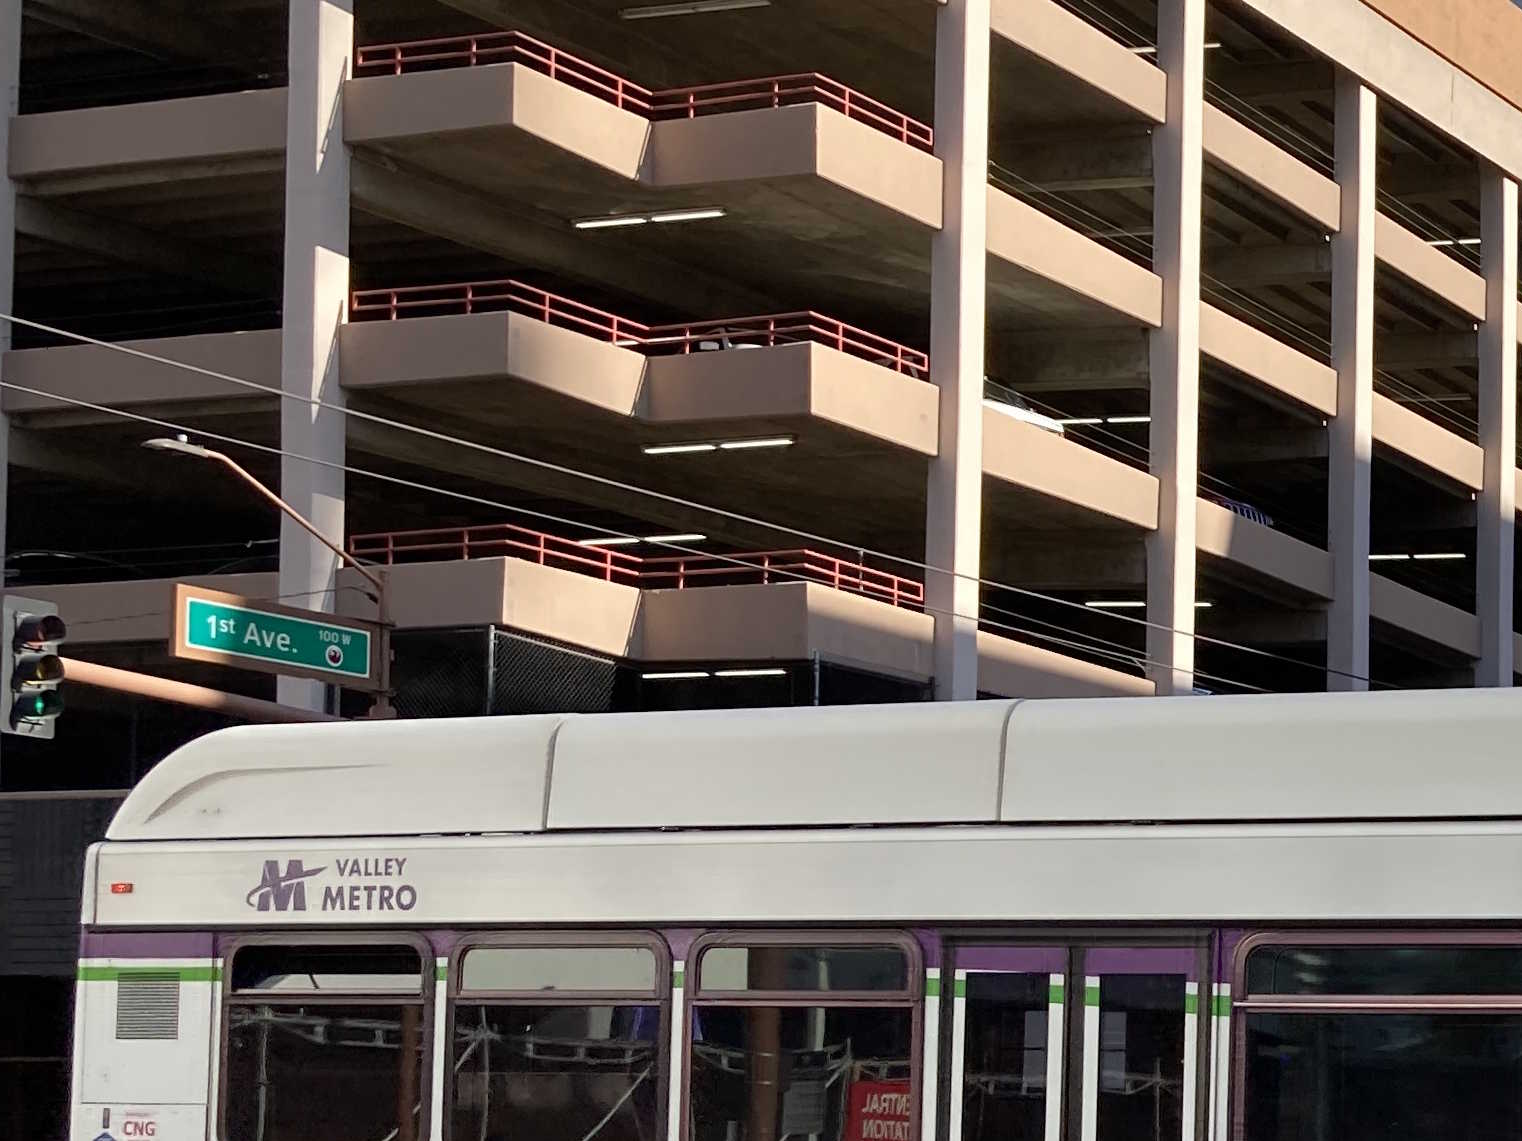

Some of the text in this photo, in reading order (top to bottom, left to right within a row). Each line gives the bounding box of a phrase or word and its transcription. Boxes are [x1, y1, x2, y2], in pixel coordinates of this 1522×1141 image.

[206, 615, 298, 653] 1st Ave.
[319, 630, 351, 645] 100 W
[336, 857, 407, 877] VALLEY
[321, 885, 417, 911] METRO
[123, 1120, 156, 1136] CNG
